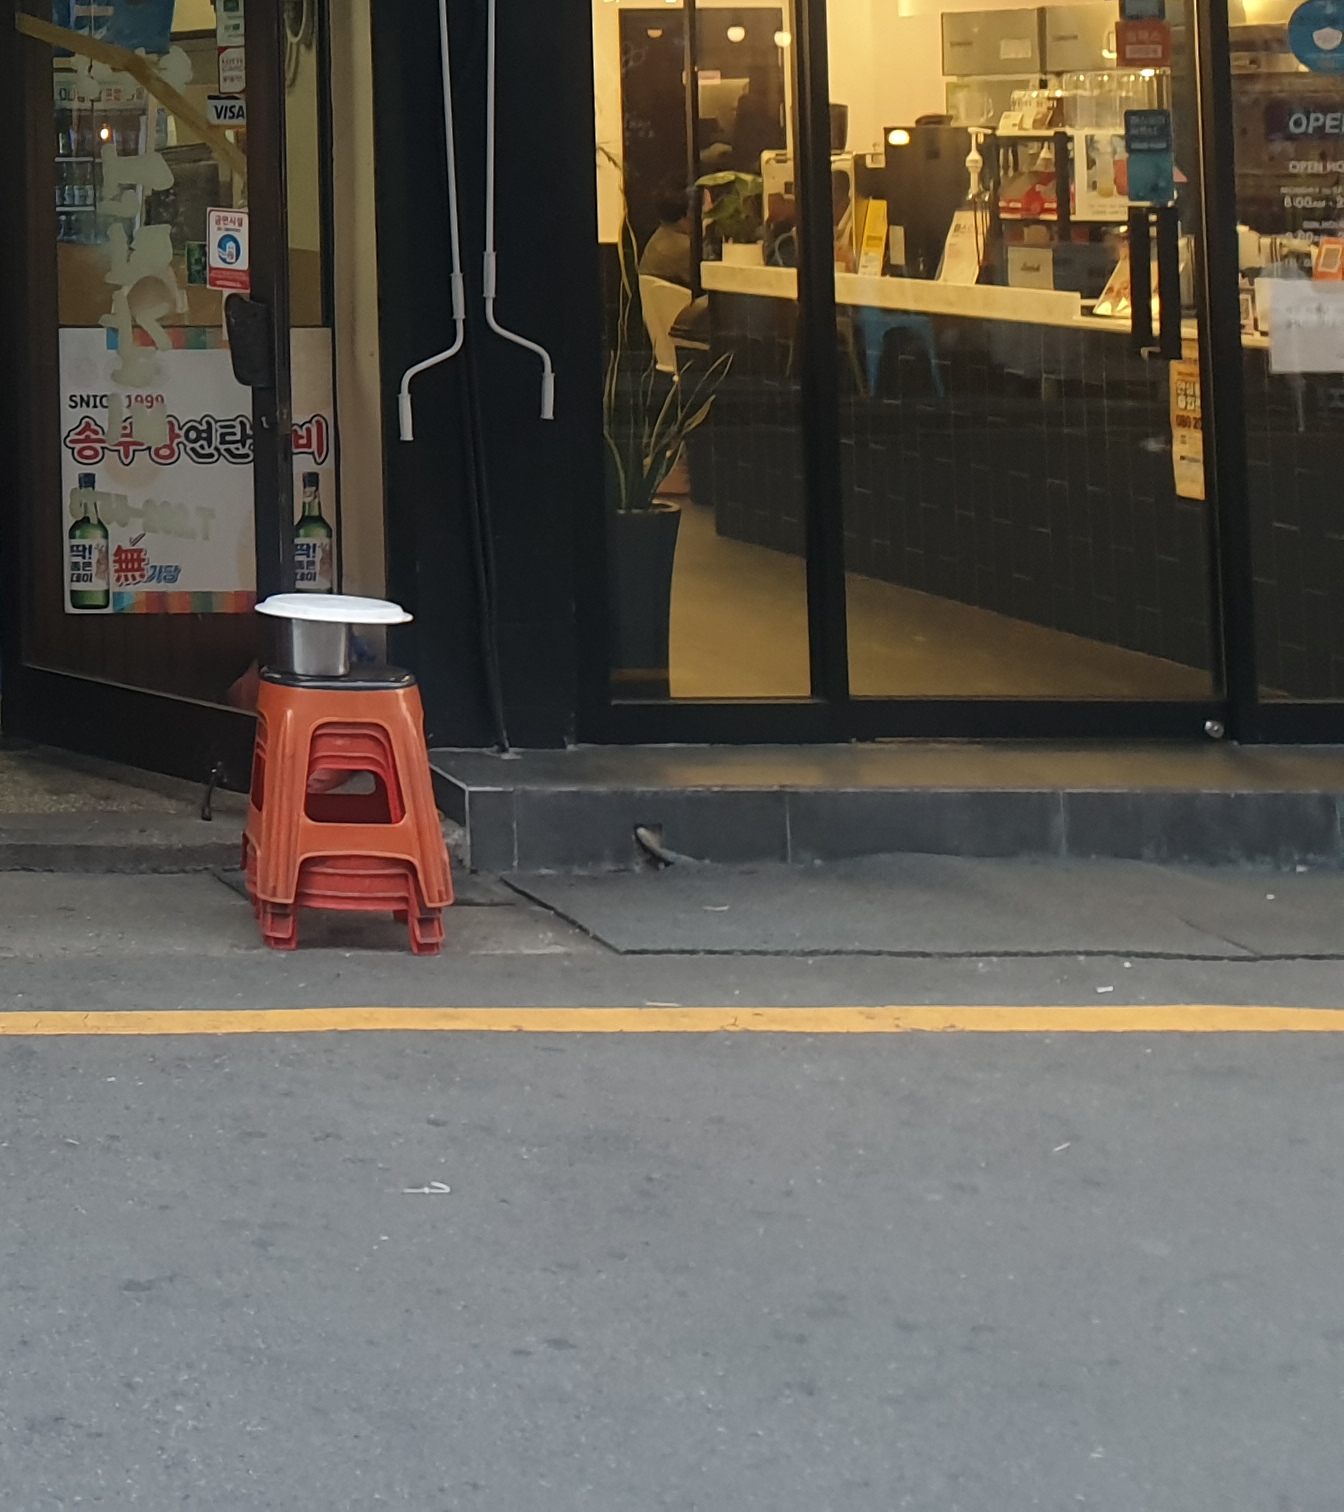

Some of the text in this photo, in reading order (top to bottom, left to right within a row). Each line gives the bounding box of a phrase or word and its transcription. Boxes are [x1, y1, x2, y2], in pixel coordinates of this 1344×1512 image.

[214, 104, 245, 120] VISA
[1289, 112, 1344, 134] OPE
[68, 394, 110, 409] SNIC
